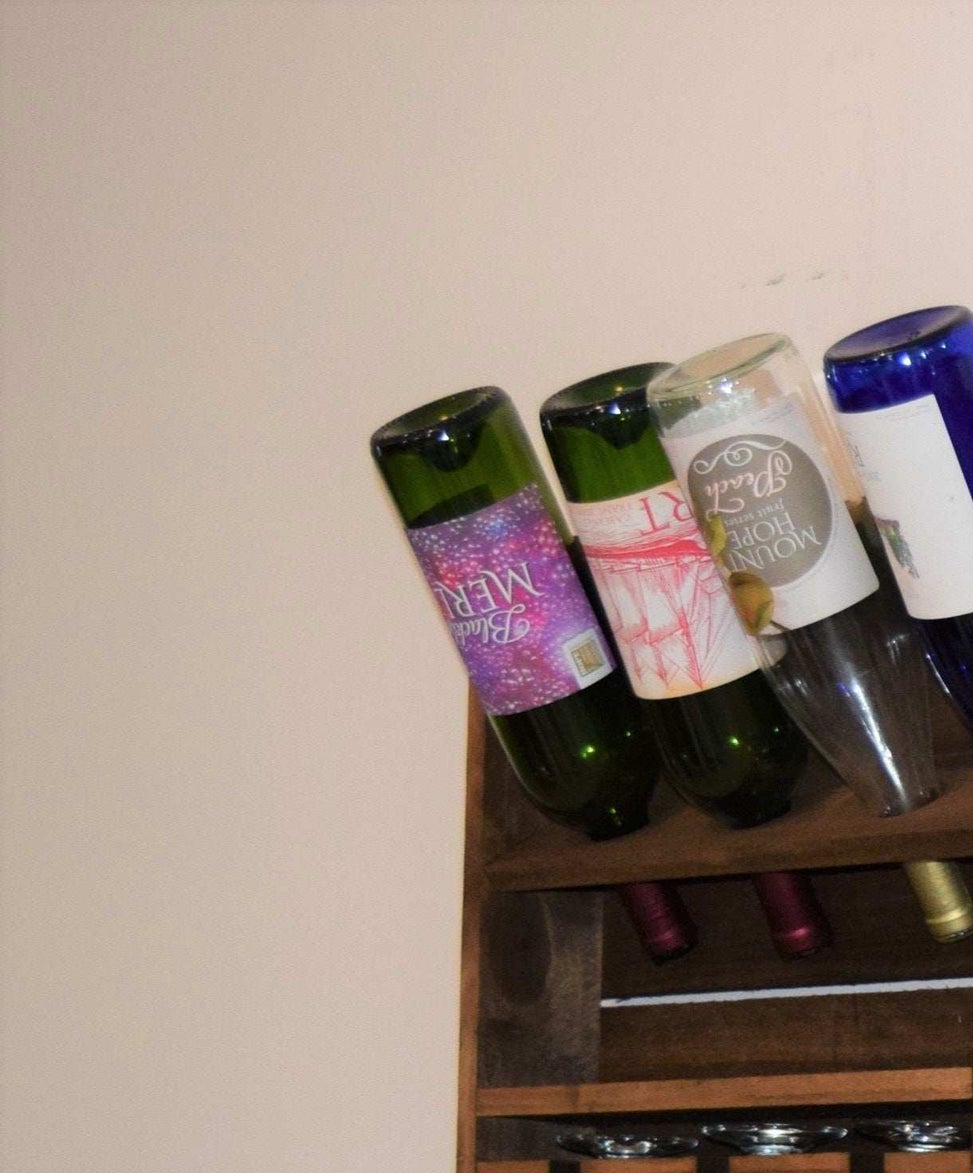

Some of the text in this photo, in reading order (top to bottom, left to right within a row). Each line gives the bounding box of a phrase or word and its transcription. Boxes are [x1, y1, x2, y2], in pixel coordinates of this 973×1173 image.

[705, 450, 793, 521] Peach
[726, 512, 796, 550] HOPE
[727, 526, 823, 573] MOUNT
